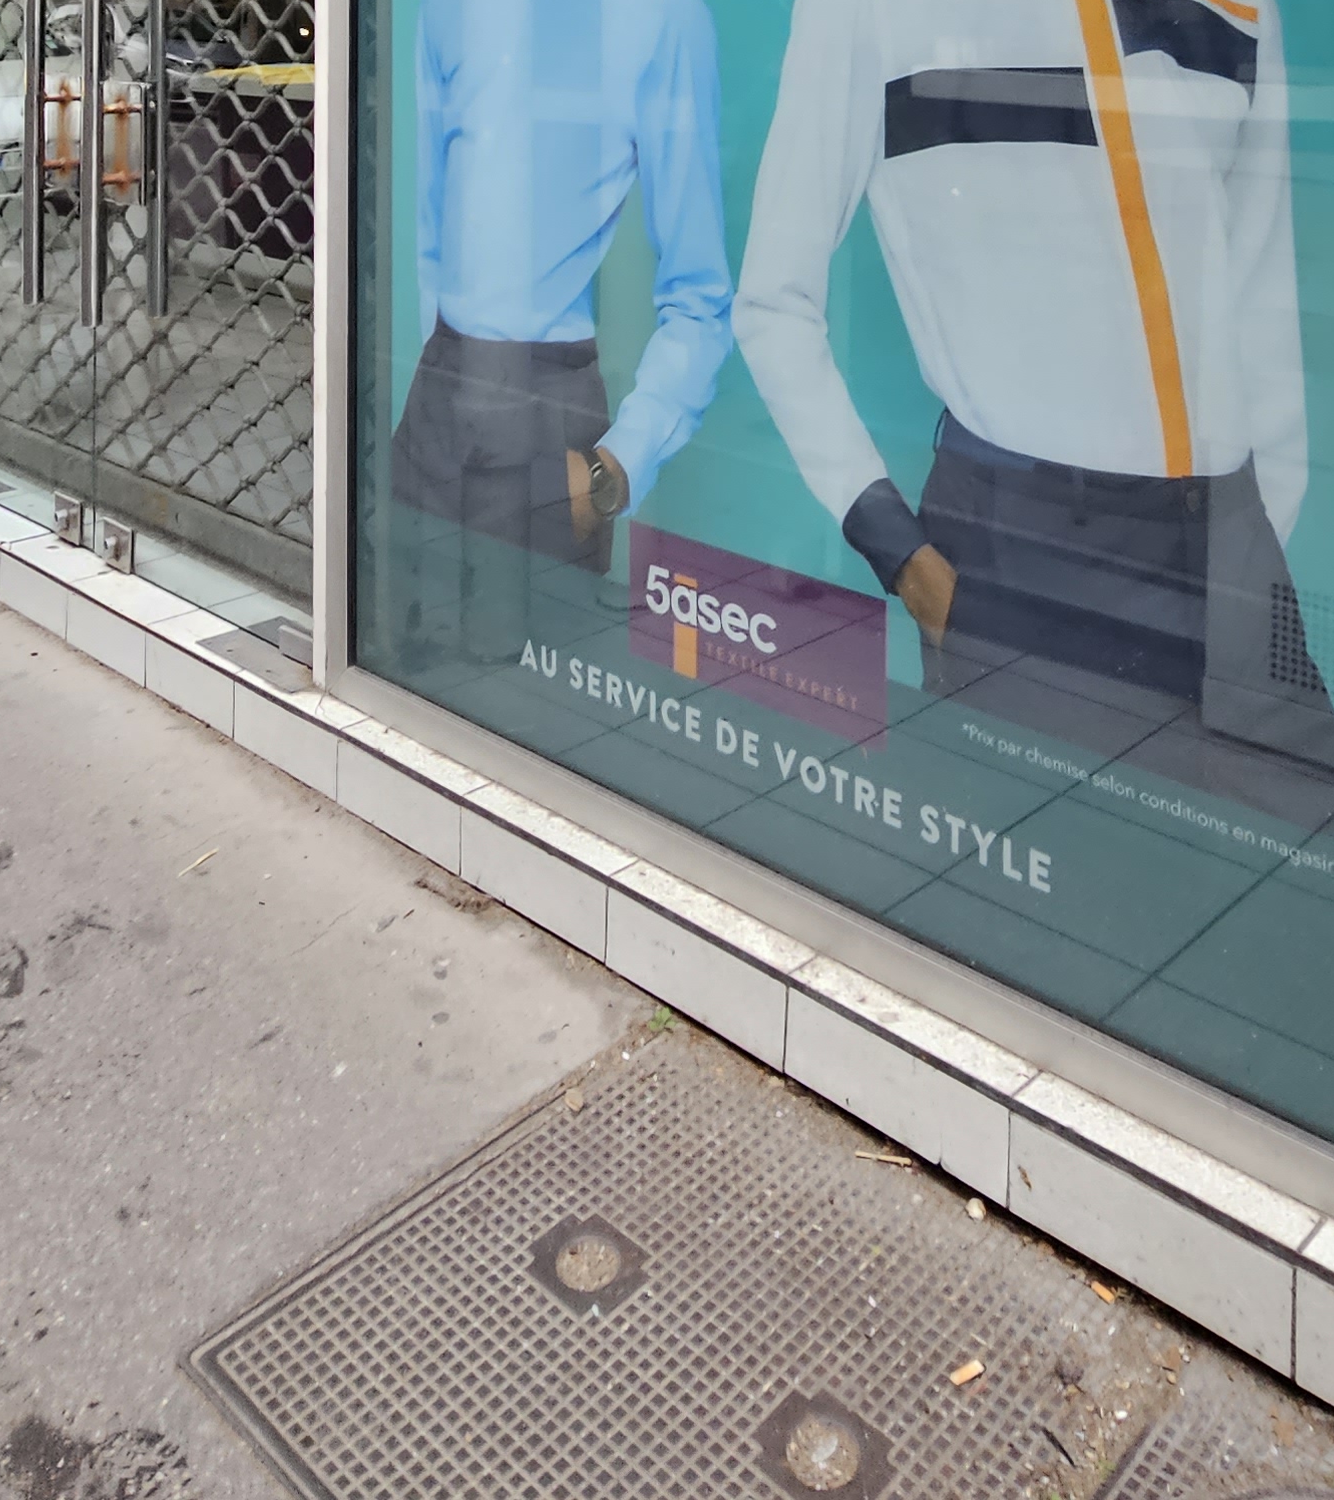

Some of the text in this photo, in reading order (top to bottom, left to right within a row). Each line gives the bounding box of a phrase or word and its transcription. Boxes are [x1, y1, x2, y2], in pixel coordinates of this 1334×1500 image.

[784, 673, 859, 711] EXPERT
[519, 639, 1053, 894] AU SERVICE DE VOTRE STYLE
[998, 737, 1022, 757] par
[1025, 746, 1089, 782] chemise
[1092, 773, 1135, 800] selon
[1138, 790, 1229, 836] conditions
[1232, 825, 1256, 846] en
